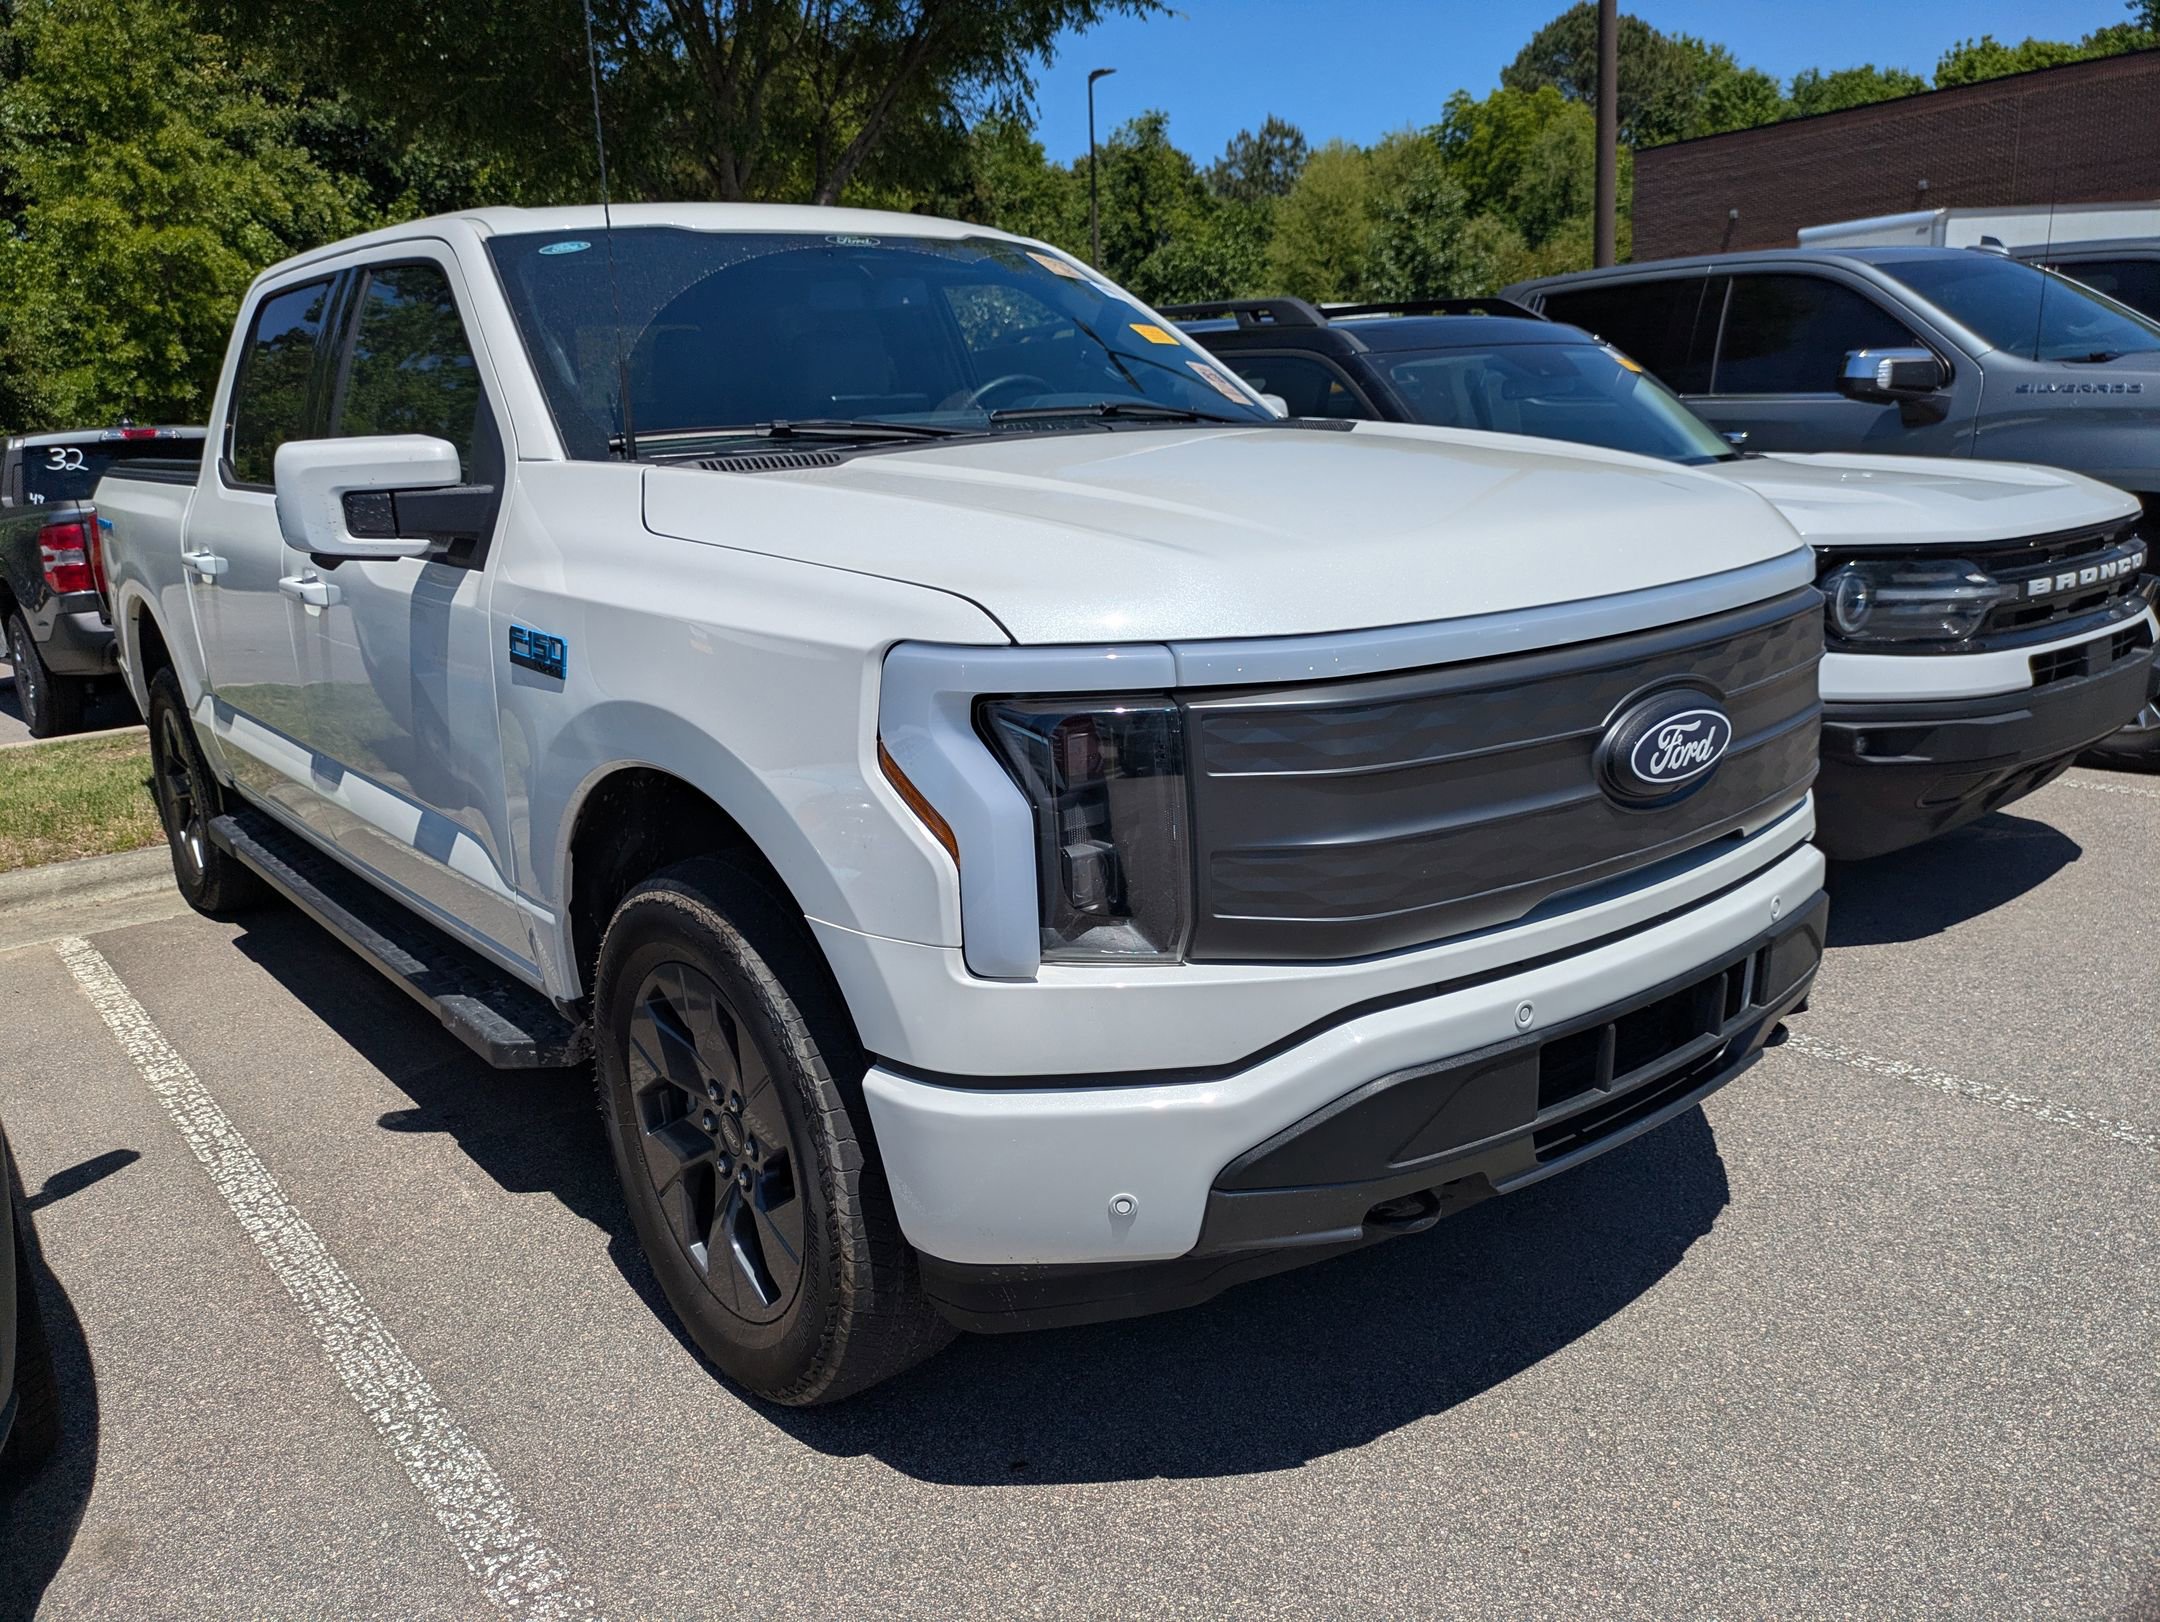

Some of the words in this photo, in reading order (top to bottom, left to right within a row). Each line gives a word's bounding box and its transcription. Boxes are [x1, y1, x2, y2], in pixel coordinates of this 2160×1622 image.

[2015, 382, 2144, 394] SILVERADO
[45, 447, 89, 471] 32
[2027, 551, 2143, 597] BRONCO
[1650, 719, 1716, 775] Ford
